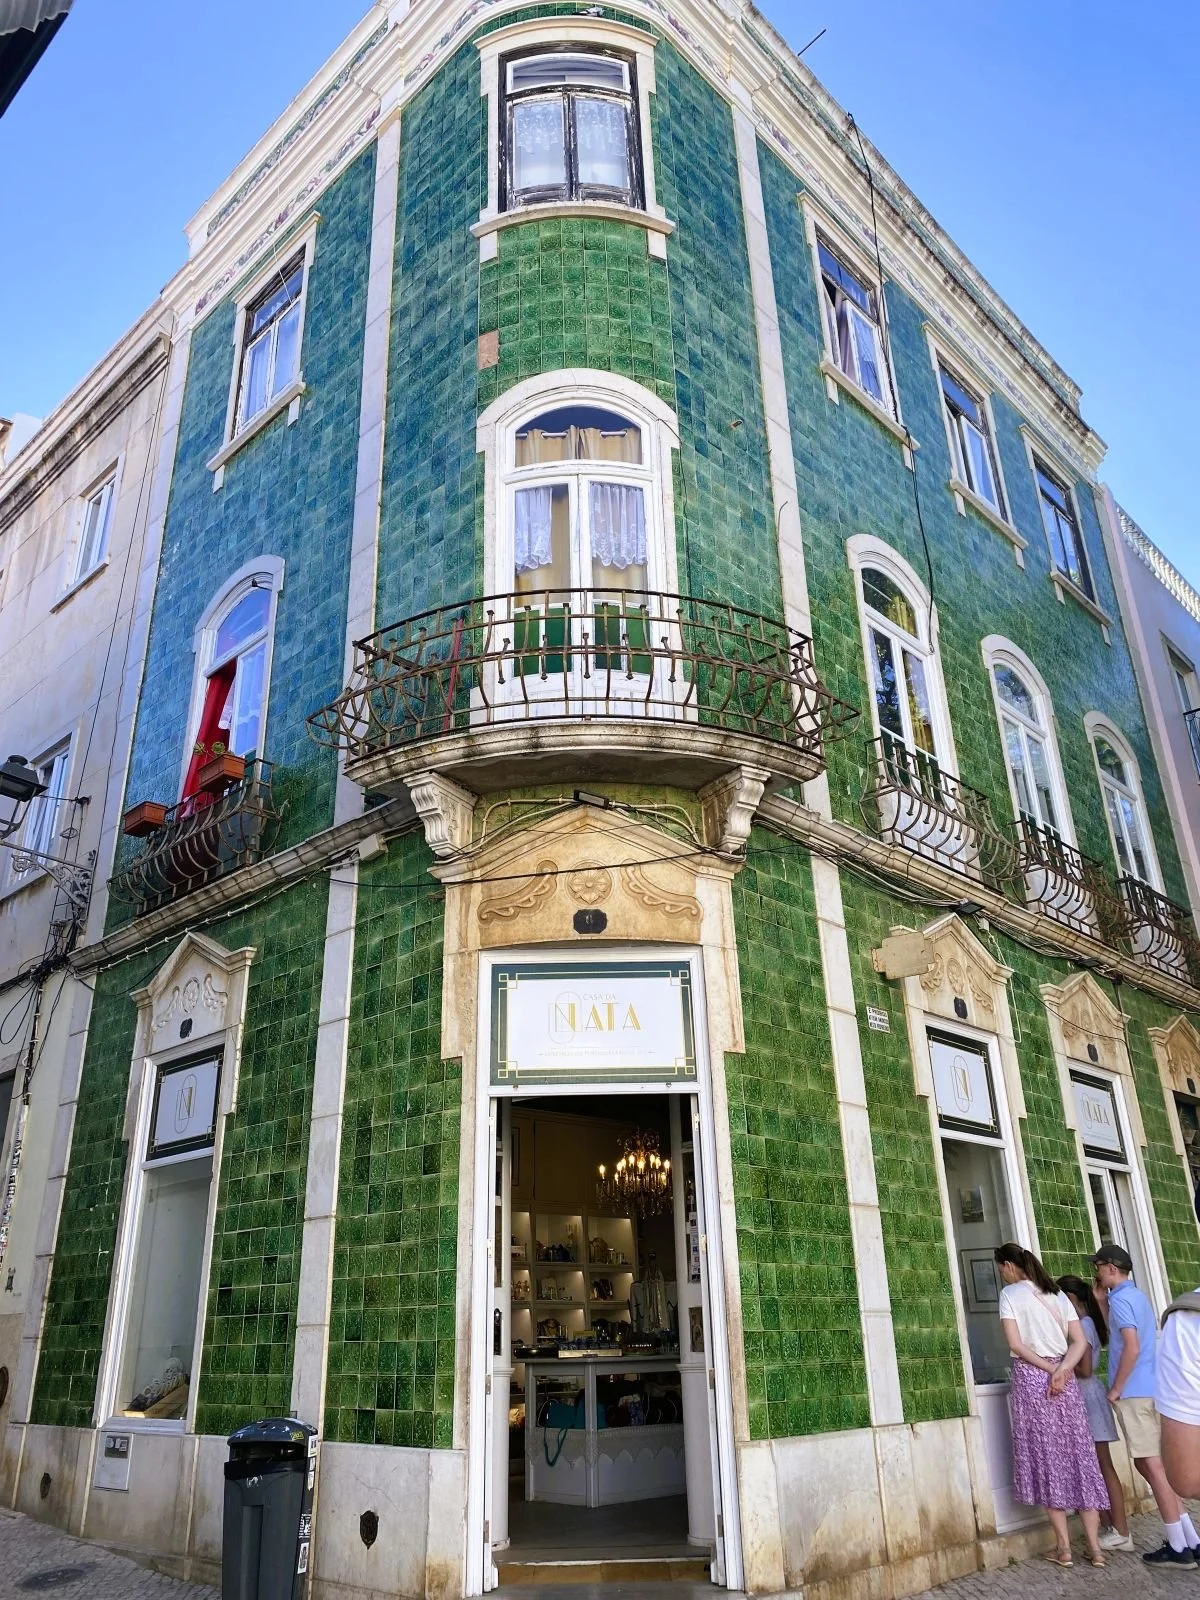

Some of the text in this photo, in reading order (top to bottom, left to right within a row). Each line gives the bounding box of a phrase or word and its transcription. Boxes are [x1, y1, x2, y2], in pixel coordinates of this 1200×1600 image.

[582, 992, 617, 1001] CASA DA
[554, 1002, 641, 1033] NATA
